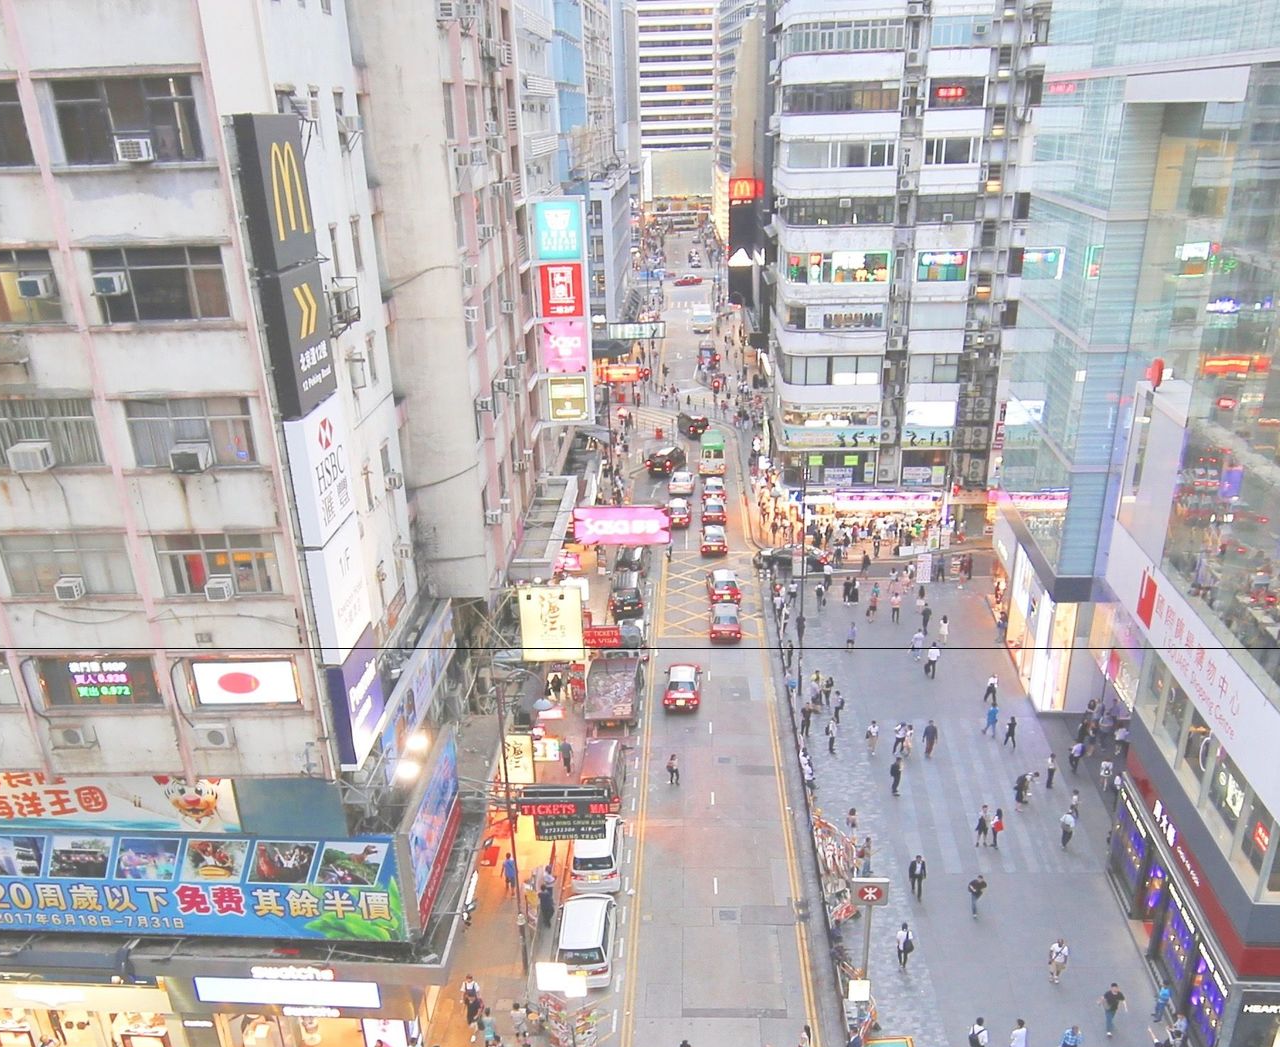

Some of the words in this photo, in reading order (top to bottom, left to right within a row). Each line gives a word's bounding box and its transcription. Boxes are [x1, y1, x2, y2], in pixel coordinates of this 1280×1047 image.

[315, 445, 345, 494] HSBC
[321, 476, 350, 526] 匯豐
[583, 518, 629, 535] Sasa
[521, 804, 576, 815] TICKETS
[252, 888, 393, 920] 其餘半價
